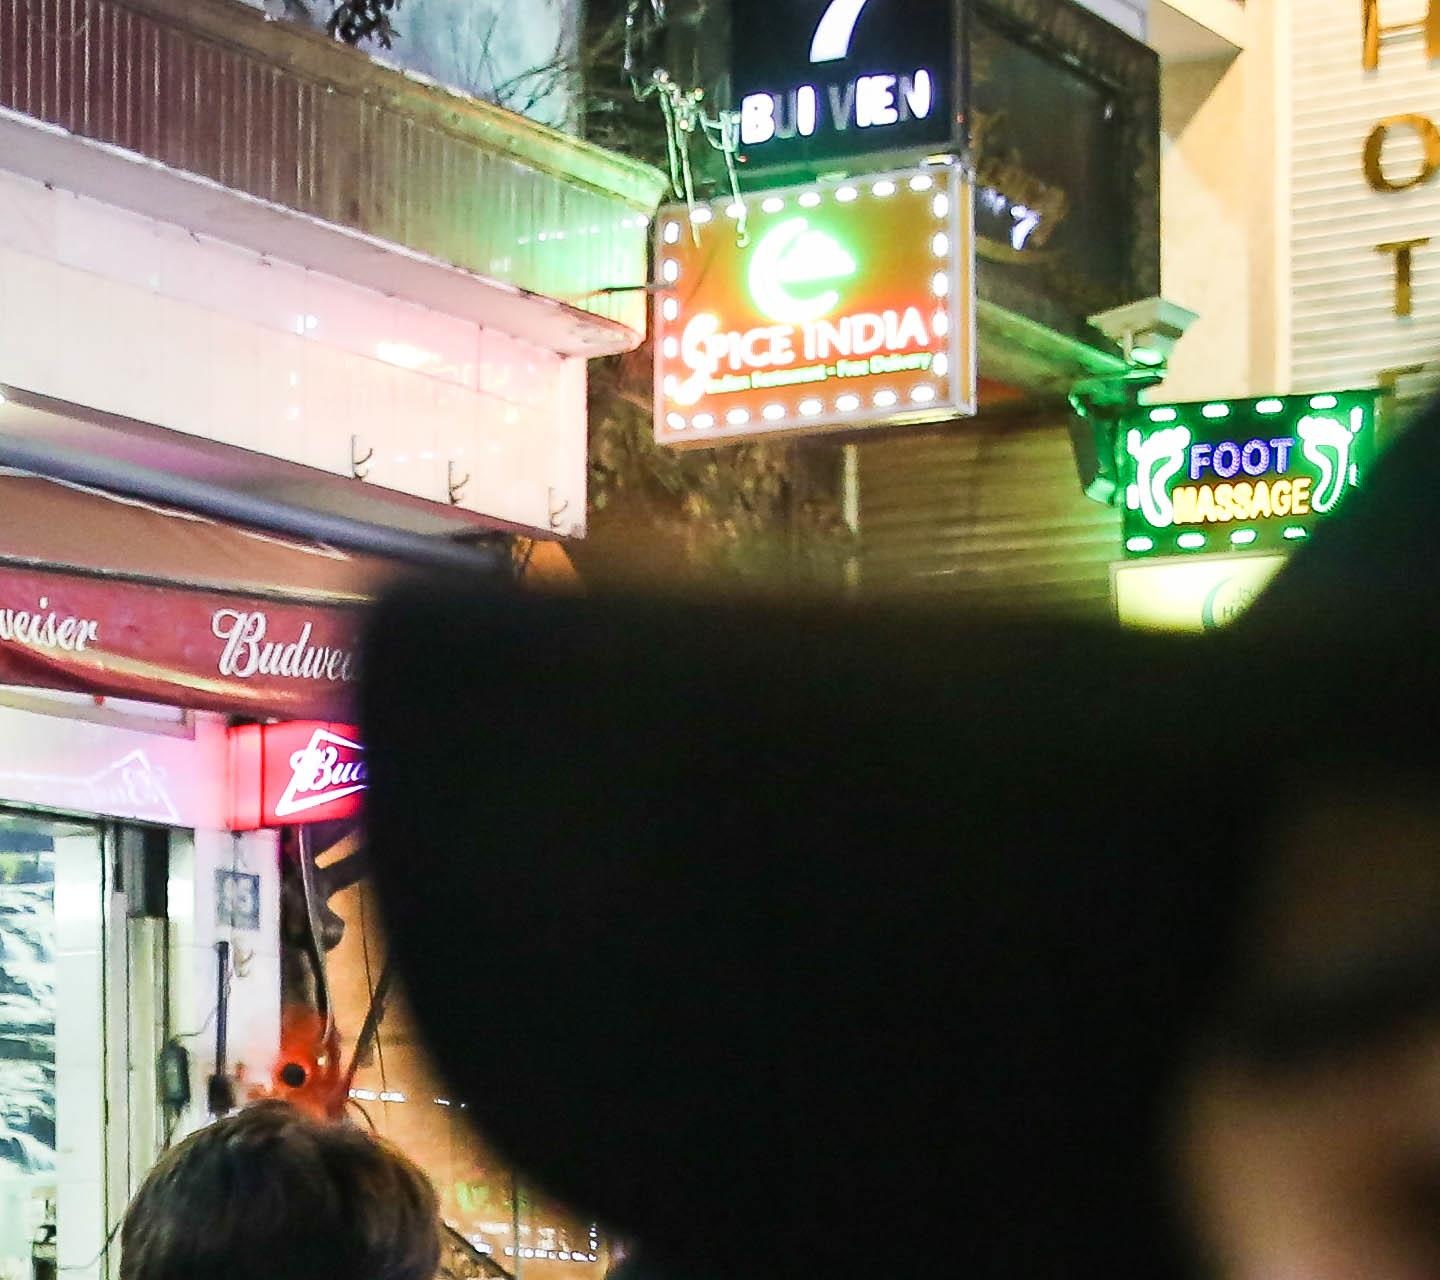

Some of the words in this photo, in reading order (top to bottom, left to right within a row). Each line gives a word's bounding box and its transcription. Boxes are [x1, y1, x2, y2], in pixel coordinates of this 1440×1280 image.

[801, 307, 929, 360] INDIA
[1189, 437, 1295, 480] FOOT
[1172, 477, 1313, 525] MASSAGE
